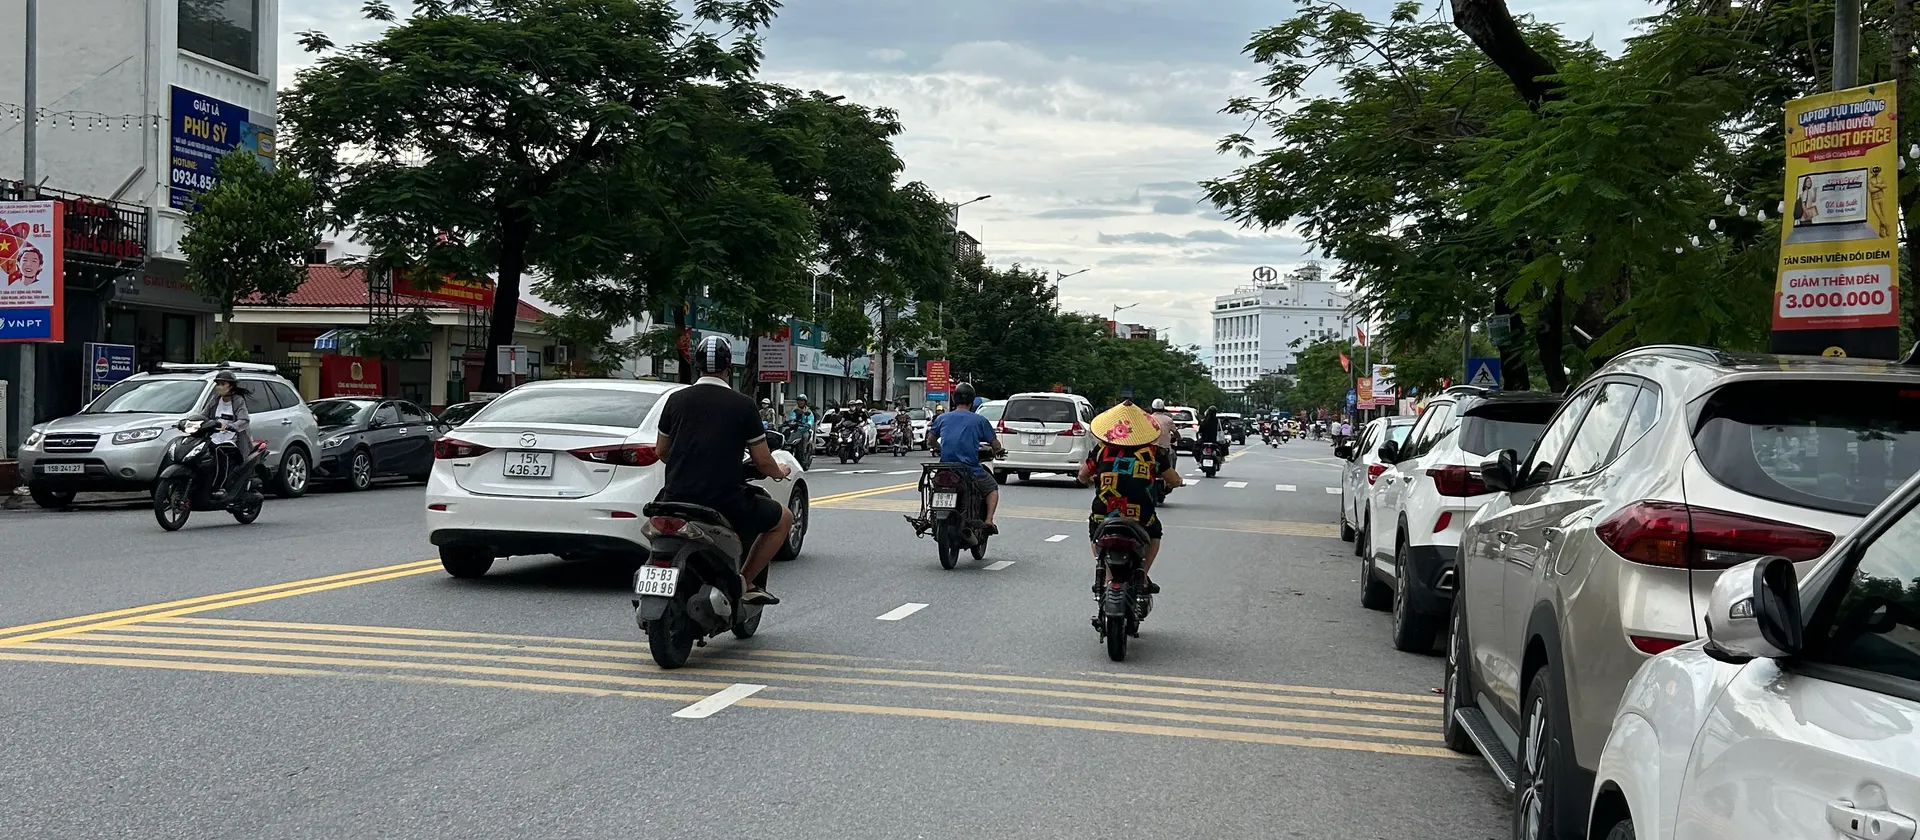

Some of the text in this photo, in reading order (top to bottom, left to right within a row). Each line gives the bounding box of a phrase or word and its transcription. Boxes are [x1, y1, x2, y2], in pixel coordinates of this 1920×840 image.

[193, 99, 220, 116] GIẶT LÀ
[1799, 98, 1886, 124] LAPTOP TỰU TRƯỜNG
[184, 115, 228, 144] PHÚ SỸ
[1804, 113, 1876, 137] TẶNG BẢN QUYỀN
[1791, 126, 1892, 157] MICROSOFT OFFICE
[33, 223, 45, 233] 81
[1783, 249, 1891, 266] TÂN SINH VIÊN ĐỔI ĐIỂM
[1789, 271, 1880, 288] GIẢM THÊM ĐẾN
[1785, 289, 1885, 309] 3.000.000
[8, 319, 42, 328] VNPT
[519, 453, 540, 464] 15K
[508, 464, 547, 476] 436.37
[646, 568, 673, 580] 15-B3
[638, 581, 674, 594] 008.96
